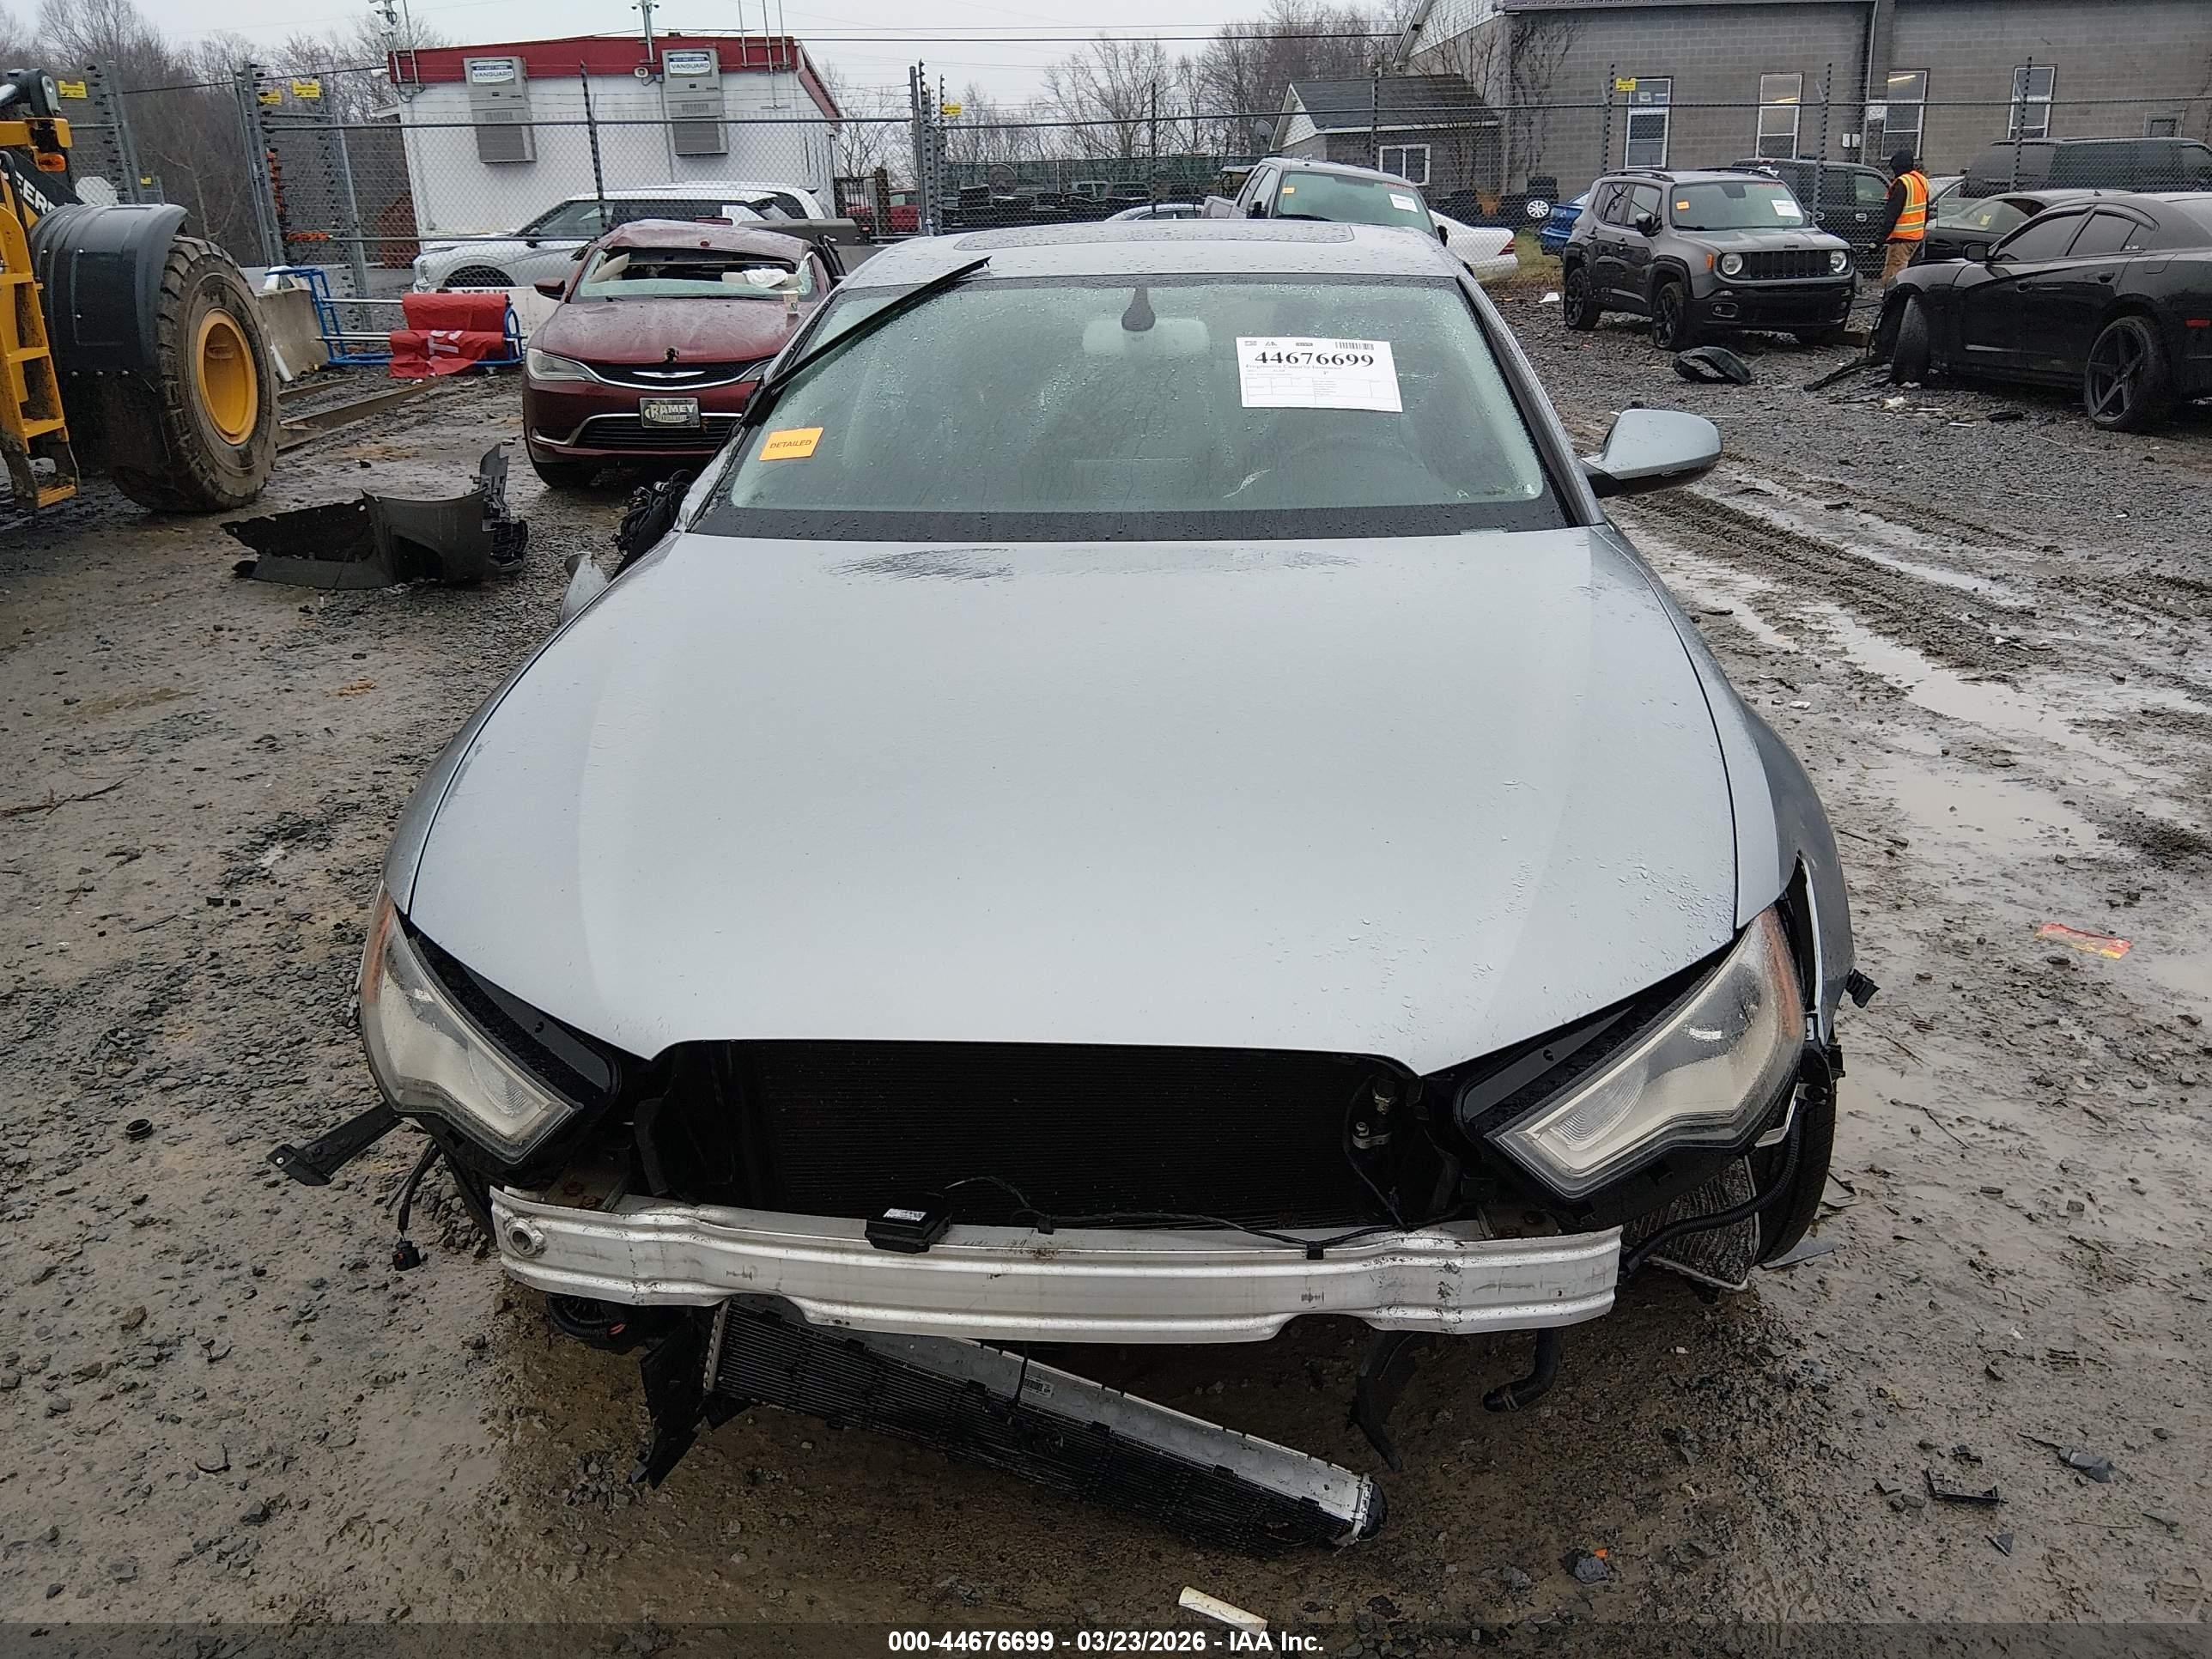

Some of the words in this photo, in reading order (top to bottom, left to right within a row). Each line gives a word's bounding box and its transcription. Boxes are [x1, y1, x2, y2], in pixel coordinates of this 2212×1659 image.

[1255, 350, 1374, 367] 44676699
[650, 404, 696, 418] RAMEY
[769, 440, 812, 448] DETAILED
